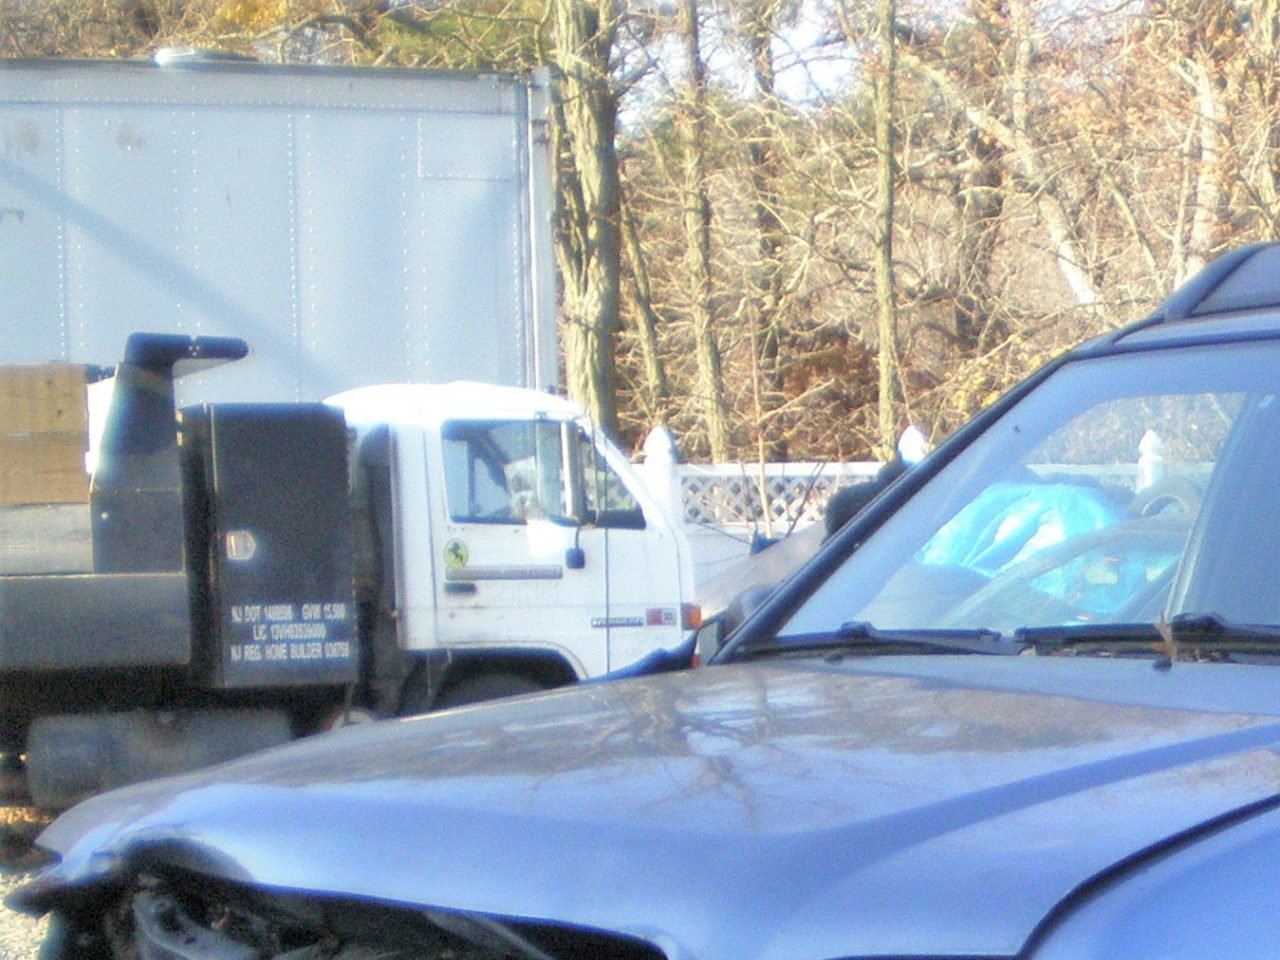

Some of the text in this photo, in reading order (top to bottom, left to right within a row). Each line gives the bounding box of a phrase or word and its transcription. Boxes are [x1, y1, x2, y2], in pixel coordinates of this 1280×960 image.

[231, 606, 242, 622] NJ
[245, 605, 261, 622] DOT
[302, 604, 321, 620] GVW
[252, 624, 268, 640] LIC
[230, 645, 242, 661] NJ
[265, 643, 288, 660] HOME
[290, 642, 322, 659] BUILDER
